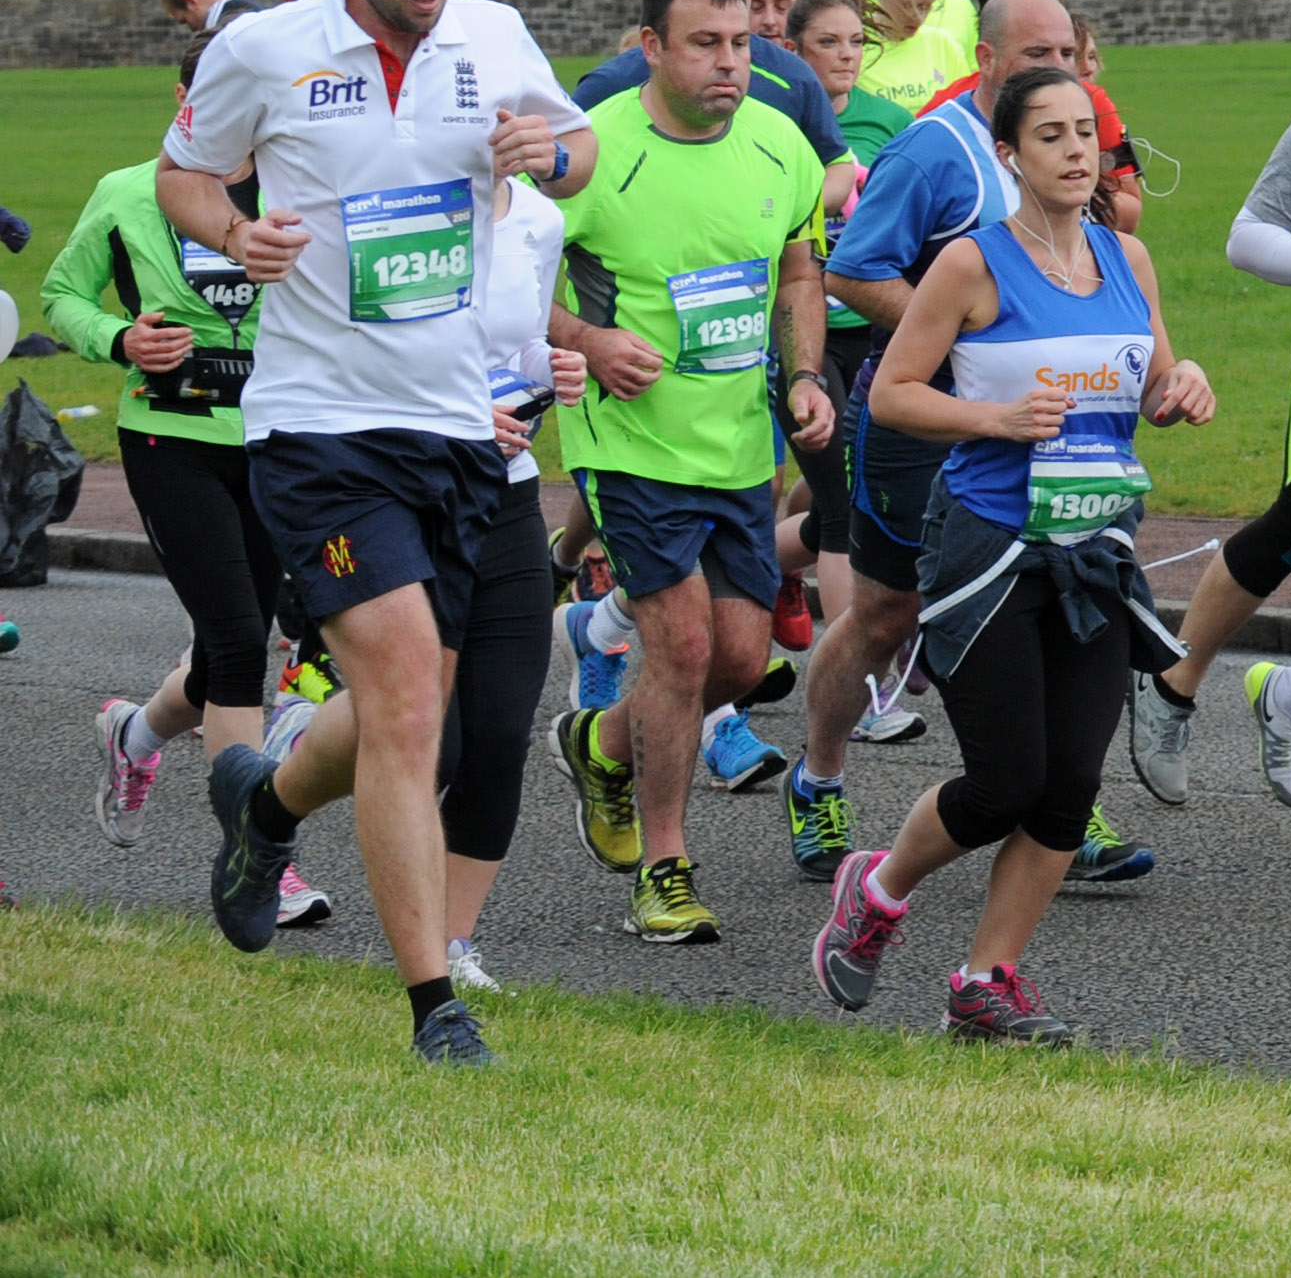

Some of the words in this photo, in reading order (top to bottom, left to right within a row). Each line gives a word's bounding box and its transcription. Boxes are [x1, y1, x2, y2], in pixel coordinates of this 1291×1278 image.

[309, 75, 367, 107] Brit
[876, 83, 928, 101] SIMBA
[309, 105, 366, 122] Insurance
[382, 194, 442, 210] marathon
[373, 244, 467, 288] 12348
[698, 270, 744, 285] marathon
[202, 282, 261, 306] 148
[697, 311, 765, 347] 12398
[1034, 363, 1120, 393] Sands
[1066, 441, 1116, 454] marathon
